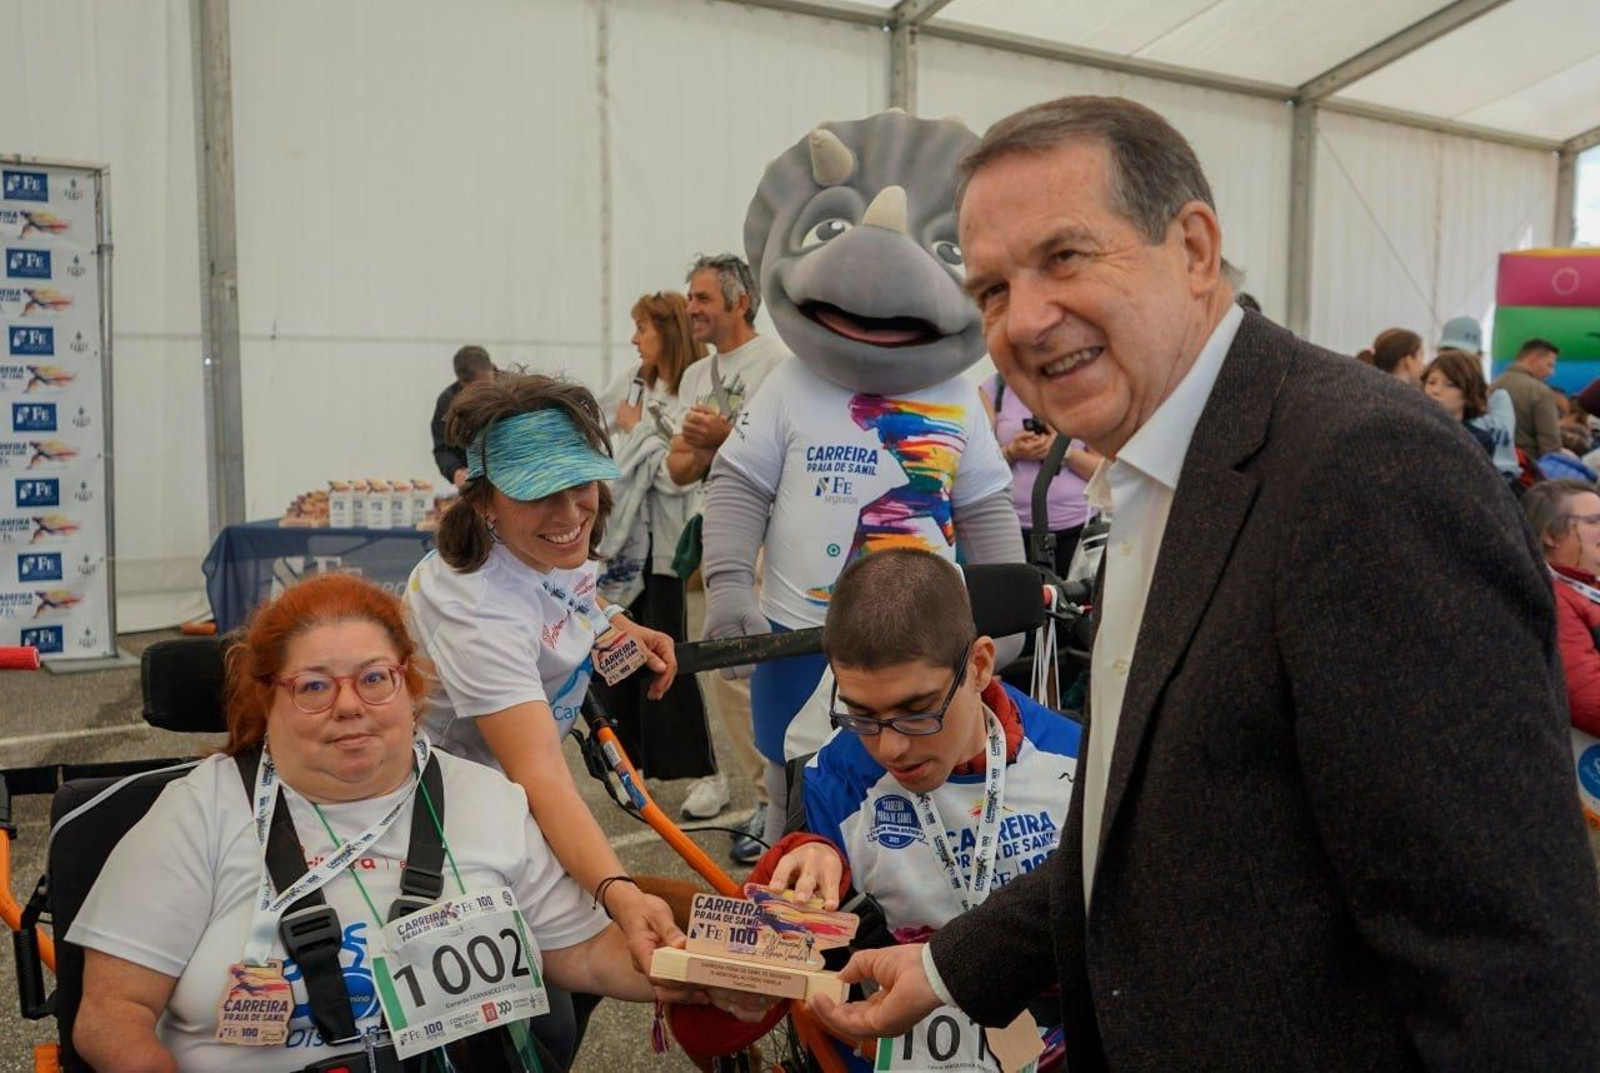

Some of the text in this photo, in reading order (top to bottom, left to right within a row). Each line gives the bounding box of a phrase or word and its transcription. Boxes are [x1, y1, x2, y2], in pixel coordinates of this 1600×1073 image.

[806, 445, 878, 465] CARREIRA
[806, 462, 832, 473] PRAIA
[834, 461, 846, 473] DE
[832, 476, 853, 495] FE
[600, 639, 637, 671] CARREIRA
[946, 811, 1057, 853] CAREIRA
[1002, 841, 1021, 859] DE
[476, 895, 494, 908] 100
[694, 896, 764, 918] CARREIRA
[398, 909, 448, 935] CARREIRA
[694, 909, 722, 923] PRAIA
[723, 914, 734, 925] DE
[402, 925, 423, 942] PRAIA
[706, 923, 758, 946] FE 100
[393, 928, 530, 1008] 1002
[223, 1000, 289, 1013] CARREIRA
[223, 1013, 250, 1021] PRAIA
[241, 1027, 259, 1038] 100
[424, 1020, 444, 1036] 100
